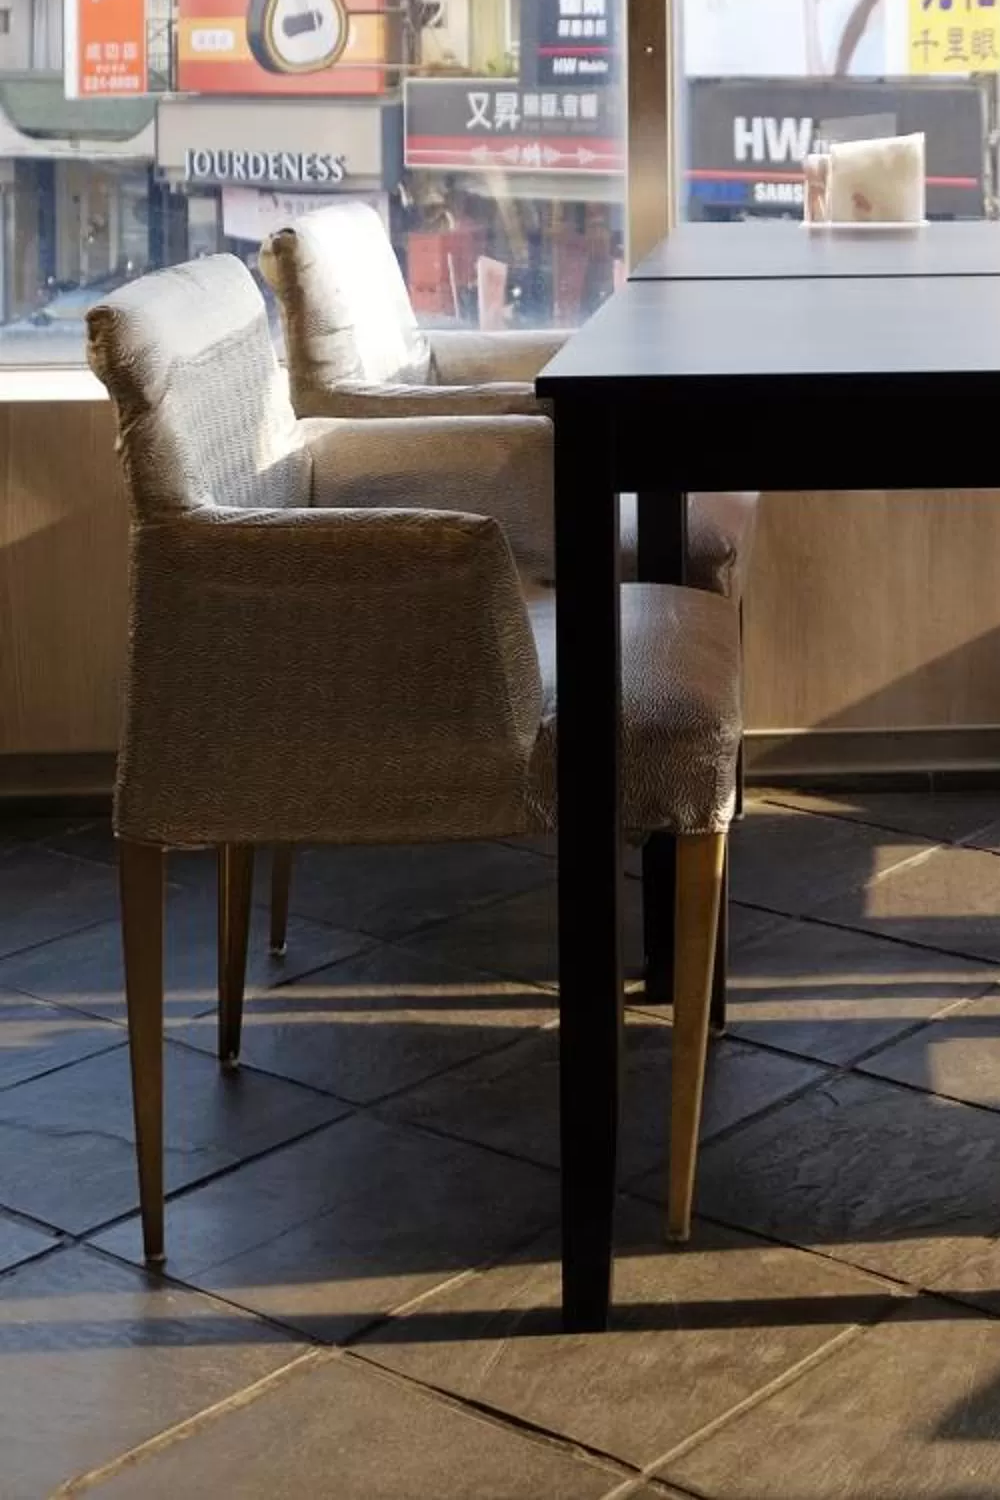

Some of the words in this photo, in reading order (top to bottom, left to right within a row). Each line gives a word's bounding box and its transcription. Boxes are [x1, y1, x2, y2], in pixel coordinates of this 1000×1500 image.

[733, 116, 813, 162] HW
[184, 148, 346, 183] JOURDENESS
[754, 182, 804, 203] SAMS
